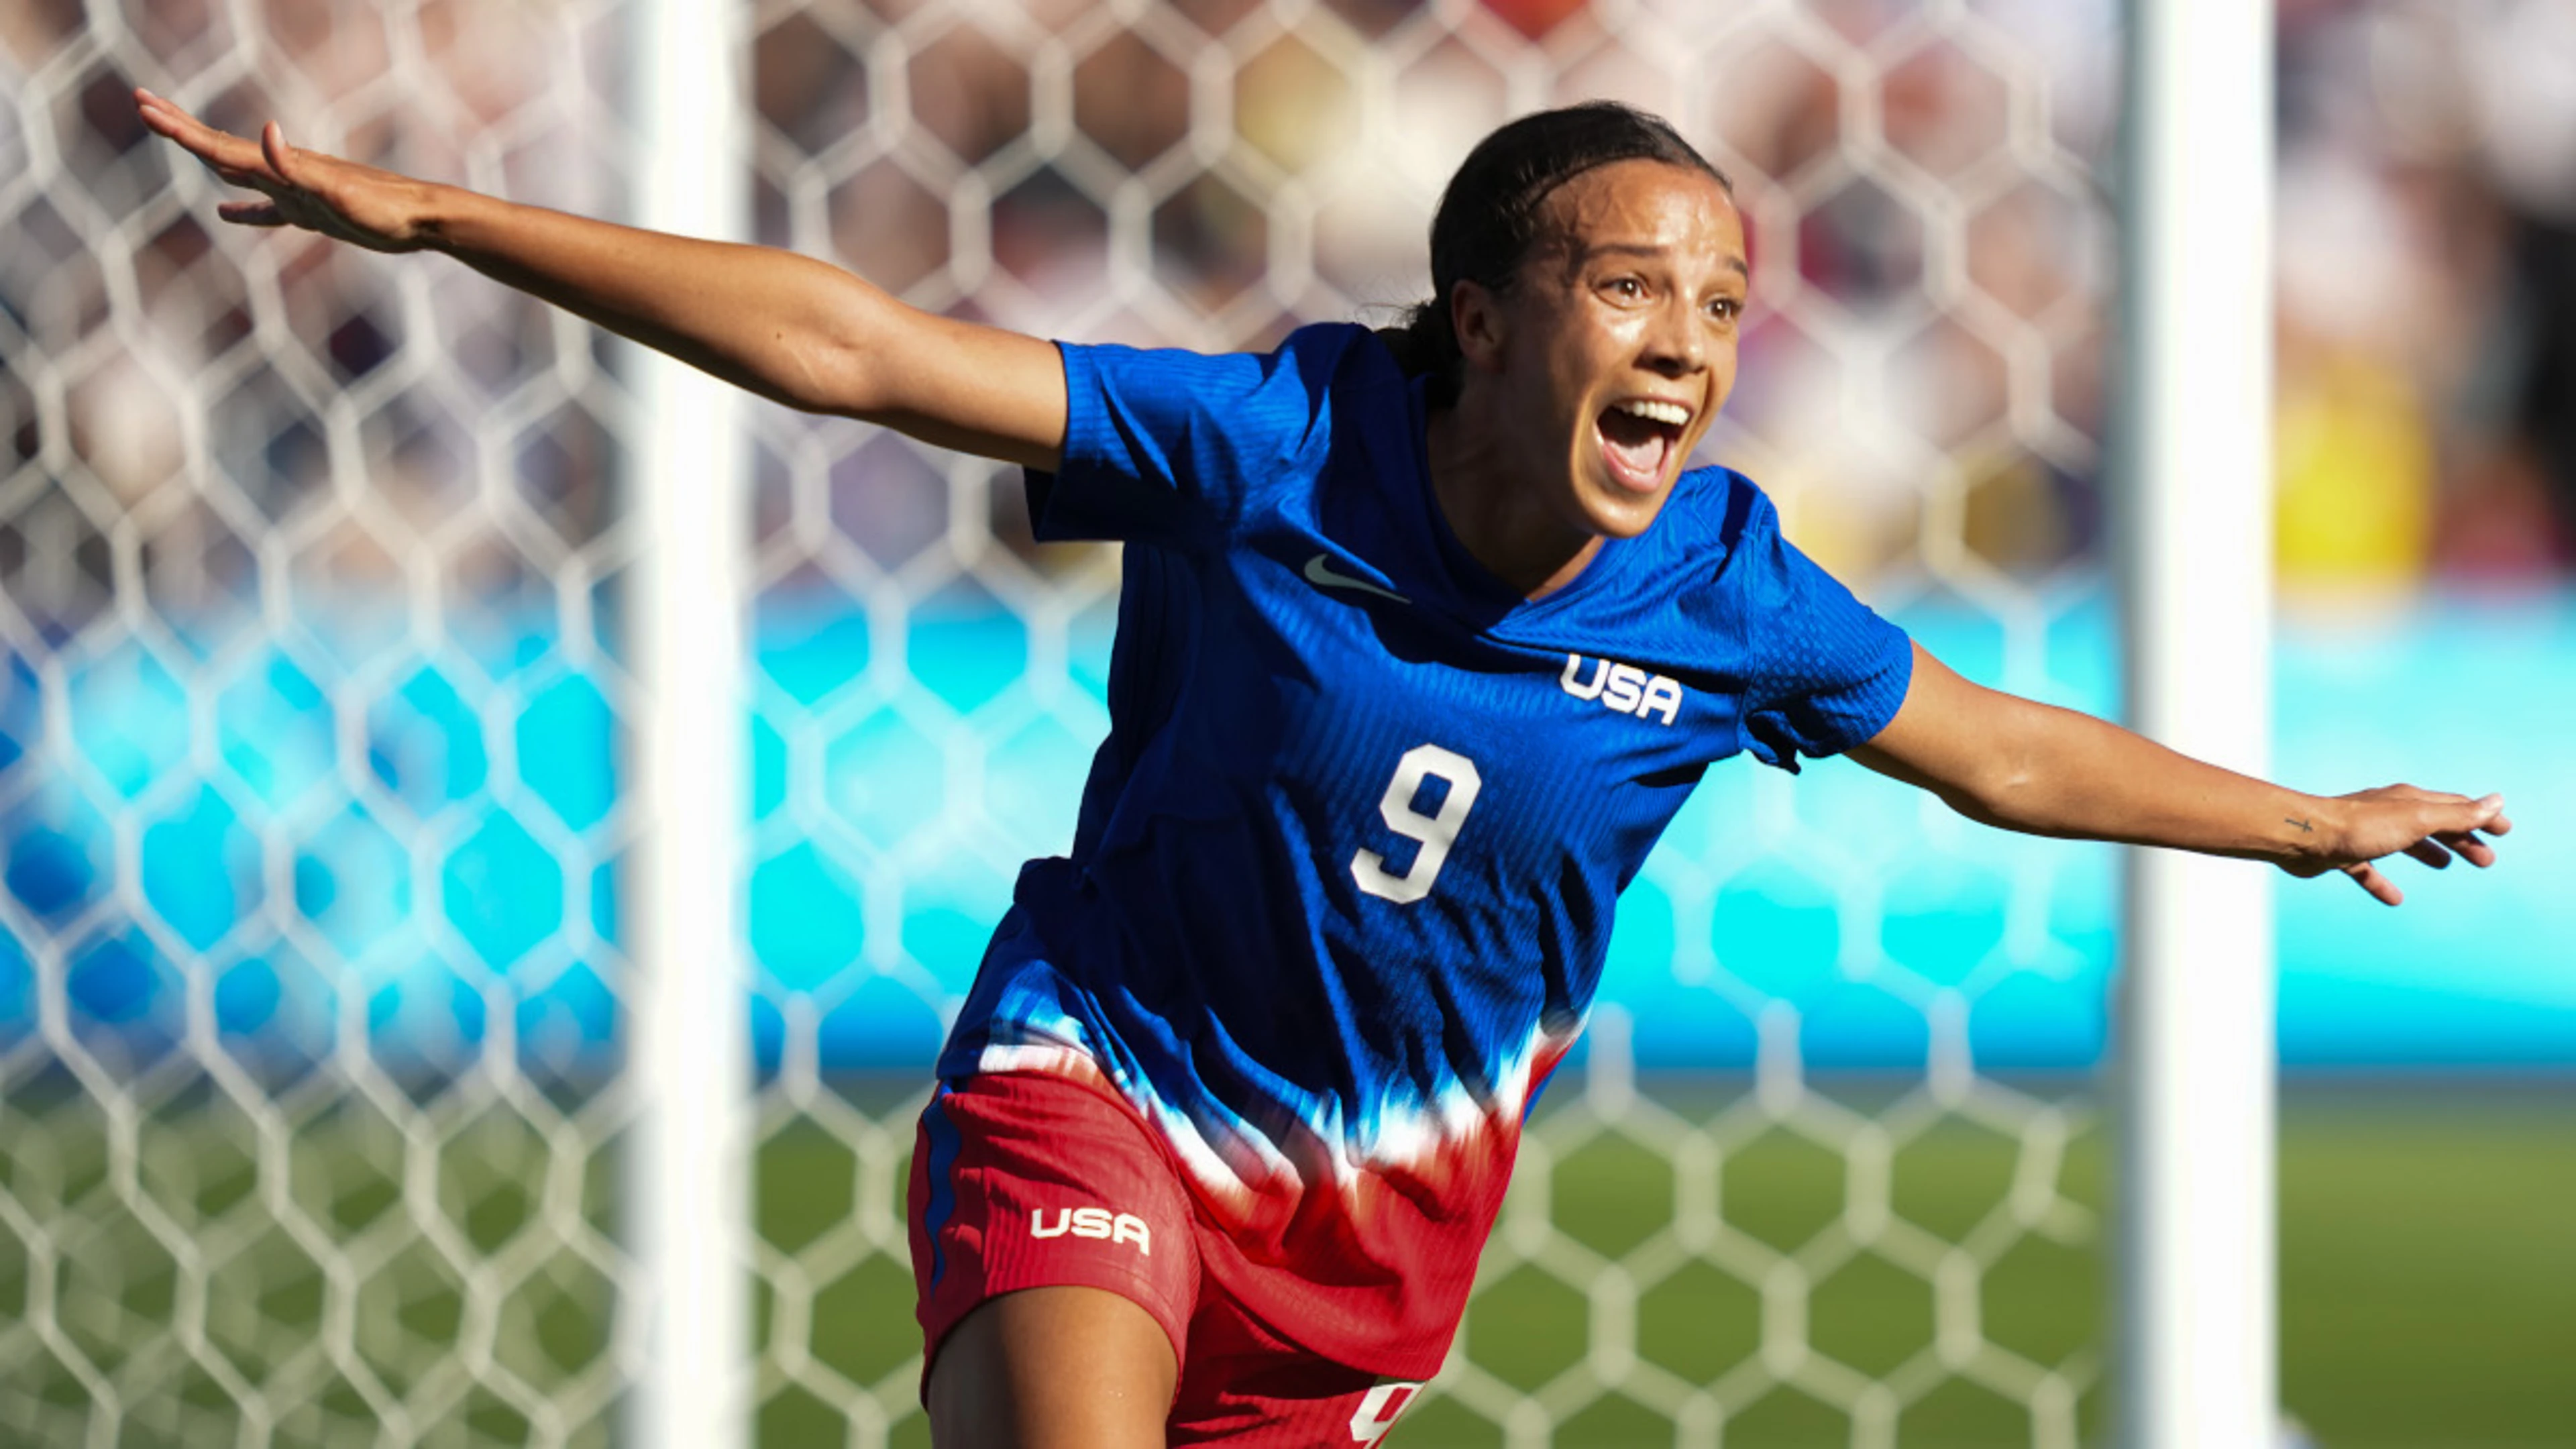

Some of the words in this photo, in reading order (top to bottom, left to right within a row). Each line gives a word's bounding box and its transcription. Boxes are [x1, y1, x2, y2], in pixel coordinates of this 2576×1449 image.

[1560, 653, 1682, 727] USA
[1350, 743, 1482, 904] 9
[1030, 1208, 1150, 1256] USA
